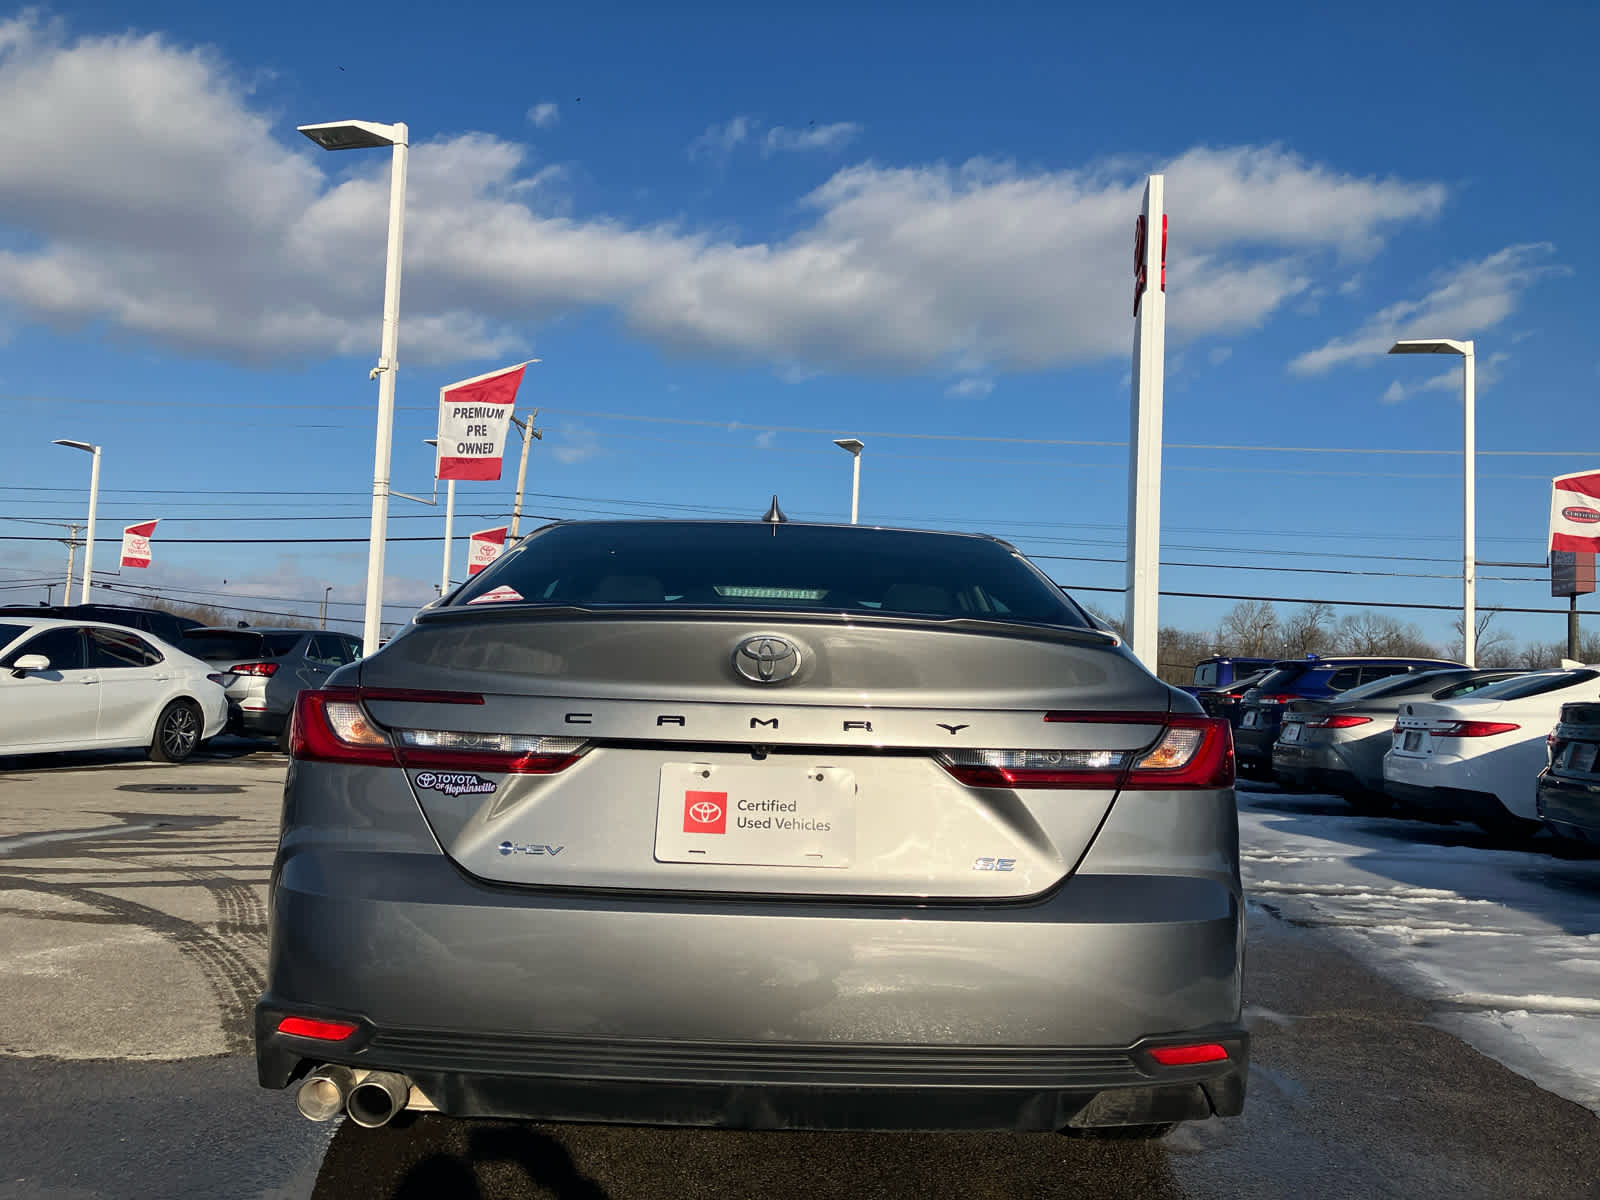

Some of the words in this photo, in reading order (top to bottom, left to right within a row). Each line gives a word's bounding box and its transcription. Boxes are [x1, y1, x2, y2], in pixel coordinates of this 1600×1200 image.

[452, 407, 505, 419] PREMIUM
[466, 424, 487, 437] PRE
[456, 442, 494, 455] OWNED
[565, 713, 969, 735] CAMRY
[436, 774, 478, 785] TOYOTA
[444, 781, 496, 796] Hopkinsville
[737, 799, 797, 813] Certified
[737, 816, 771, 830] Used
[775, 817, 831, 832] Vehicles
[972, 857, 1017, 871] SE
